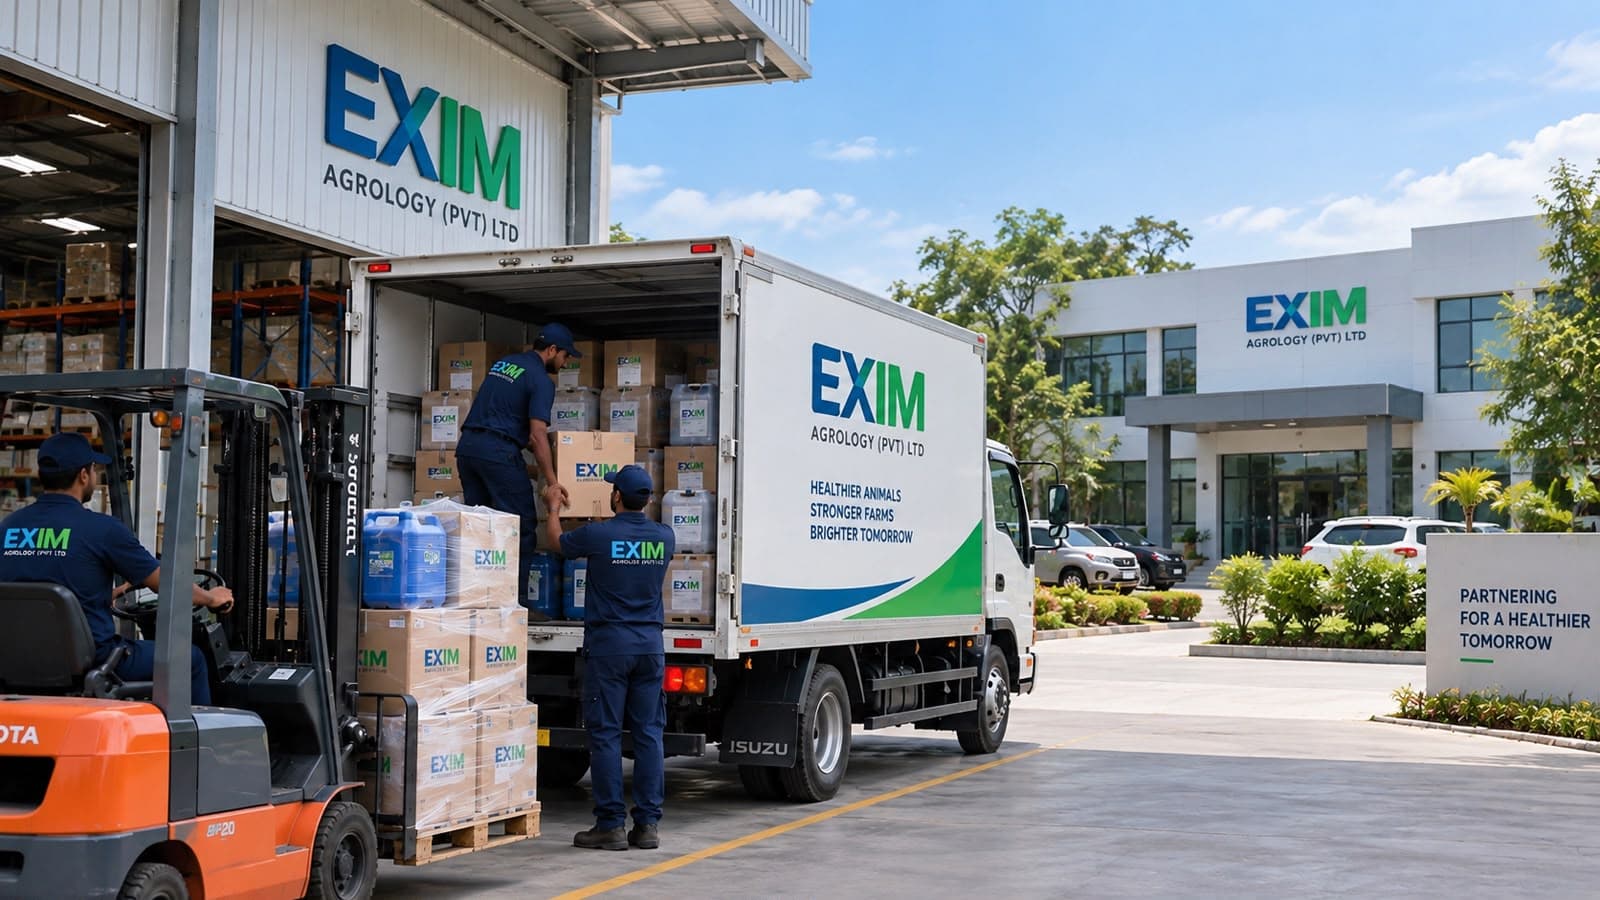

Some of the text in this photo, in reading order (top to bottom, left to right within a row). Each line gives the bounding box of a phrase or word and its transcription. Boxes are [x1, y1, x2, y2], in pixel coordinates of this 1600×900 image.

[324, 43, 521, 210] EXIM
[323, 163, 519, 243] AGROLOGY (PVT) LTD
[1246, 286, 1367, 332] EXIM
[1246, 330, 1367, 348] AGROLOGY (PVT) LTD
[812, 342, 925, 432] EXIM
[433, 414, 456, 424] EXIM
[612, 409, 635, 418] EXIM
[681, 408, 705, 418] EXIM
[811, 425, 925, 457] AGROLOGY (PVT) LTD
[810, 480, 902, 502] HEALTHIER ANIMALS
[674, 515, 699, 524] EXIM
[810, 503, 894, 522] STRONGER FARMS
[4, 527, 72, 550] EXIM
[810, 525, 913, 543] BRIGHTER TOMORROW
[475, 550, 506, 565] EXIM
[611, 541, 664, 559] EXIM
[673, 580, 699, 590] EXIM
[1460, 588, 1557, 604] PARTNERING
[1460, 611, 1591, 628] FOR A HEALTHIER
[1460, 633, 1553, 650] TOMORROW
[425, 648, 459, 667] EXIM
[486, 645, 517, 663] EXIM
[495, 745, 525, 763] EXIM
[729, 740, 788, 755] ISUZU
[431, 753, 464, 773] EXIM
